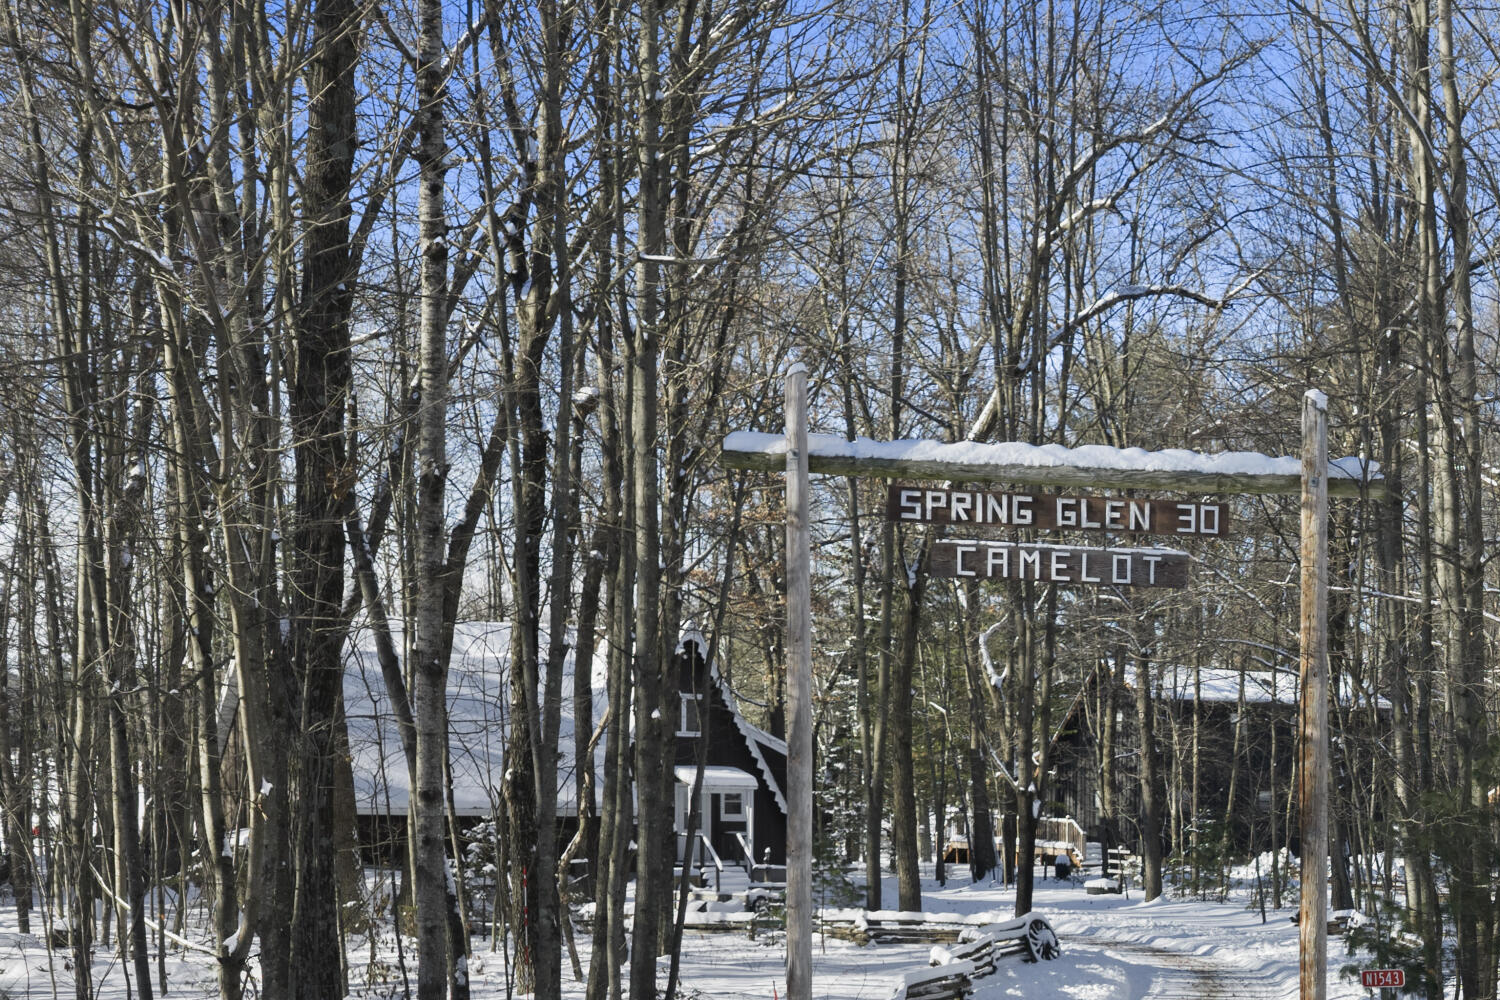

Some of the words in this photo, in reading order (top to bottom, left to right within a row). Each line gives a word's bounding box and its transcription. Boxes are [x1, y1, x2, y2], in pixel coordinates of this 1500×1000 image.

[900, 490, 1033, 525] SPRING
[1057, 498, 1150, 531] GLEN
[1177, 504, 1219, 534] 30
[957, 546, 1162, 585] CAMELOT
[1366, 972, 1400, 986] N1543
